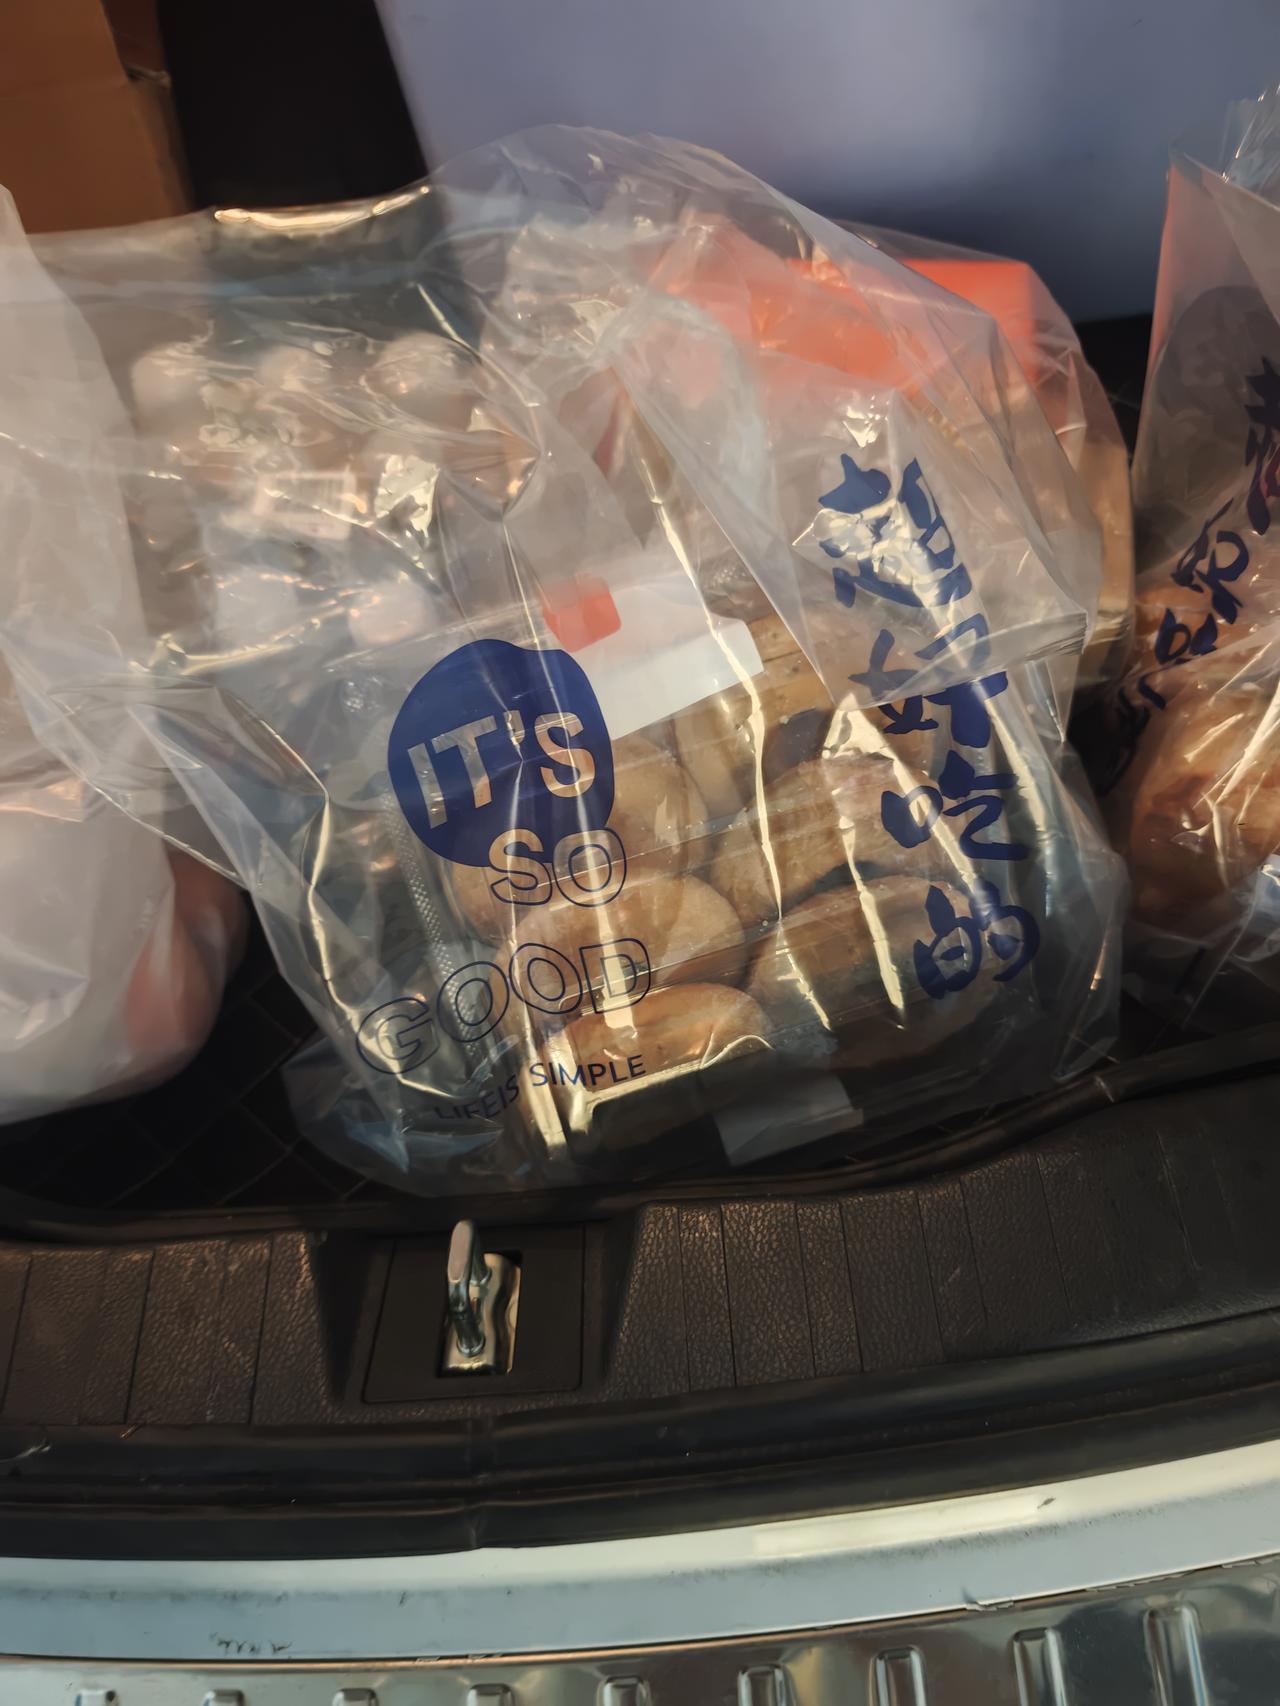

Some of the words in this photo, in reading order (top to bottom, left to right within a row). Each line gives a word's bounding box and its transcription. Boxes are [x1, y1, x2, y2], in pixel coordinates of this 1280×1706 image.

[406, 709, 596, 829] IT'S
[487, 827, 628, 908] SO
[356, 937, 652, 1075] GOOD
[528, 1054, 646, 1089] SIMPLE
